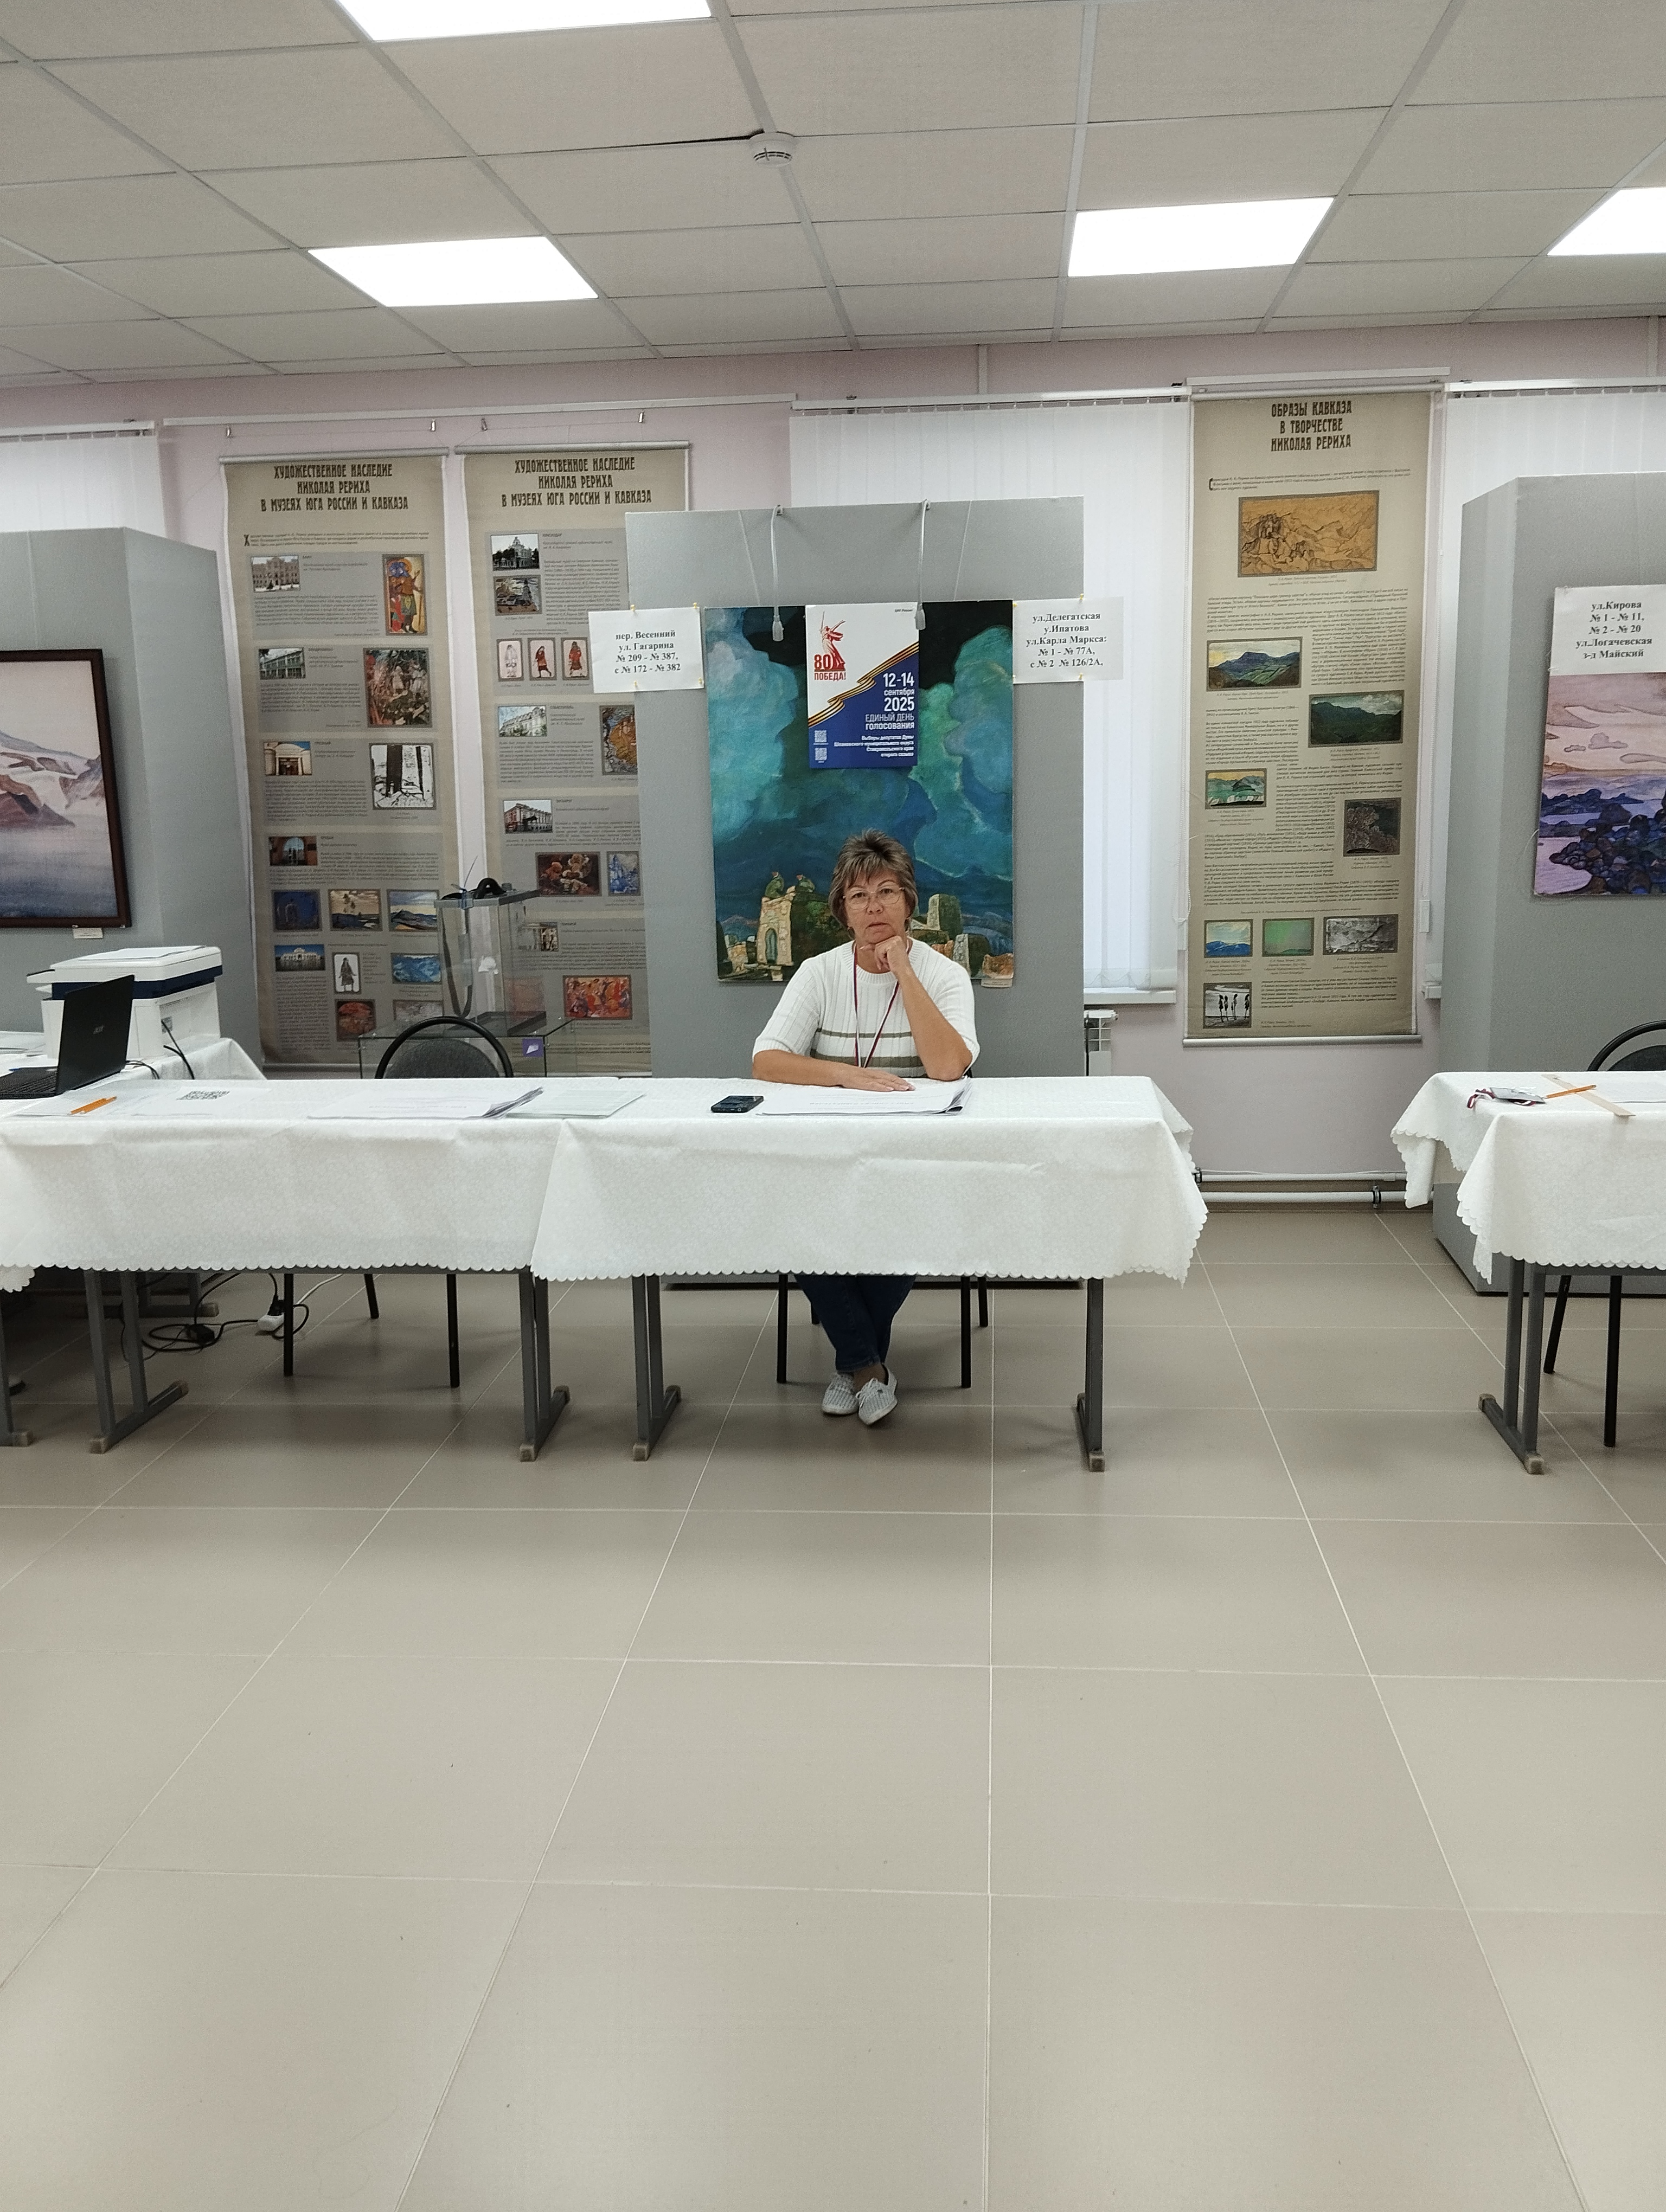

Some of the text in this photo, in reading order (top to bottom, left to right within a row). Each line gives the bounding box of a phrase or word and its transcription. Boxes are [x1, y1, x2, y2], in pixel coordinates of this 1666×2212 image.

[1272, 400, 1351, 417] ОБРАЗЫ КАВКАЗА
[1280, 418, 1343, 434] В ТВОРЧЕСТВЕ
[1271, 435, 1351, 452] НИКОЛАЯ РЕРИХА
[274, 464, 392, 479] ХУДОЖЕСТВЕННОЕ НАСЛЕДИЕ
[515, 457, 635, 473] ХУДОЖЕСТВЕННОЕ НАСЛЕДИЕ
[297, 480, 370, 494] НИКОЛАЯ РЕРИХА
[539, 474, 613, 488] НИКОЛАЯ РЕРИХА
[261, 496, 408, 511] В МУЗЕЯХ ЮГА РОССИИ И КАВКАЗА
[502, 490, 652, 507] В МУЗЕЯХ ЮГА РОССИИ И КАВКАЗА
[1591, 601, 1642, 612] ул.Кирова
[1033, 613, 1101, 623] ул.Делегатская
[635, 630, 676, 639] Весенний
[1044, 625, 1089, 634] у.Ипатова
[1630, 625, 1641, 633] 20
[634, 643, 674, 651] Гагарина
[1026, 637, 1067, 647] ул.Карла
[1599, 649, 1644, 658] Майский
[814, 654, 832, 670] 80
[814, 672, 846, 681] ПОБЕДА!
[883, 673, 914, 687] 12-14
[884, 688, 914, 697] сентября
[884, 698, 914, 711] 2025
[866, 712, 914, 722] ЕДИНЫЙ ДЕНЬ
